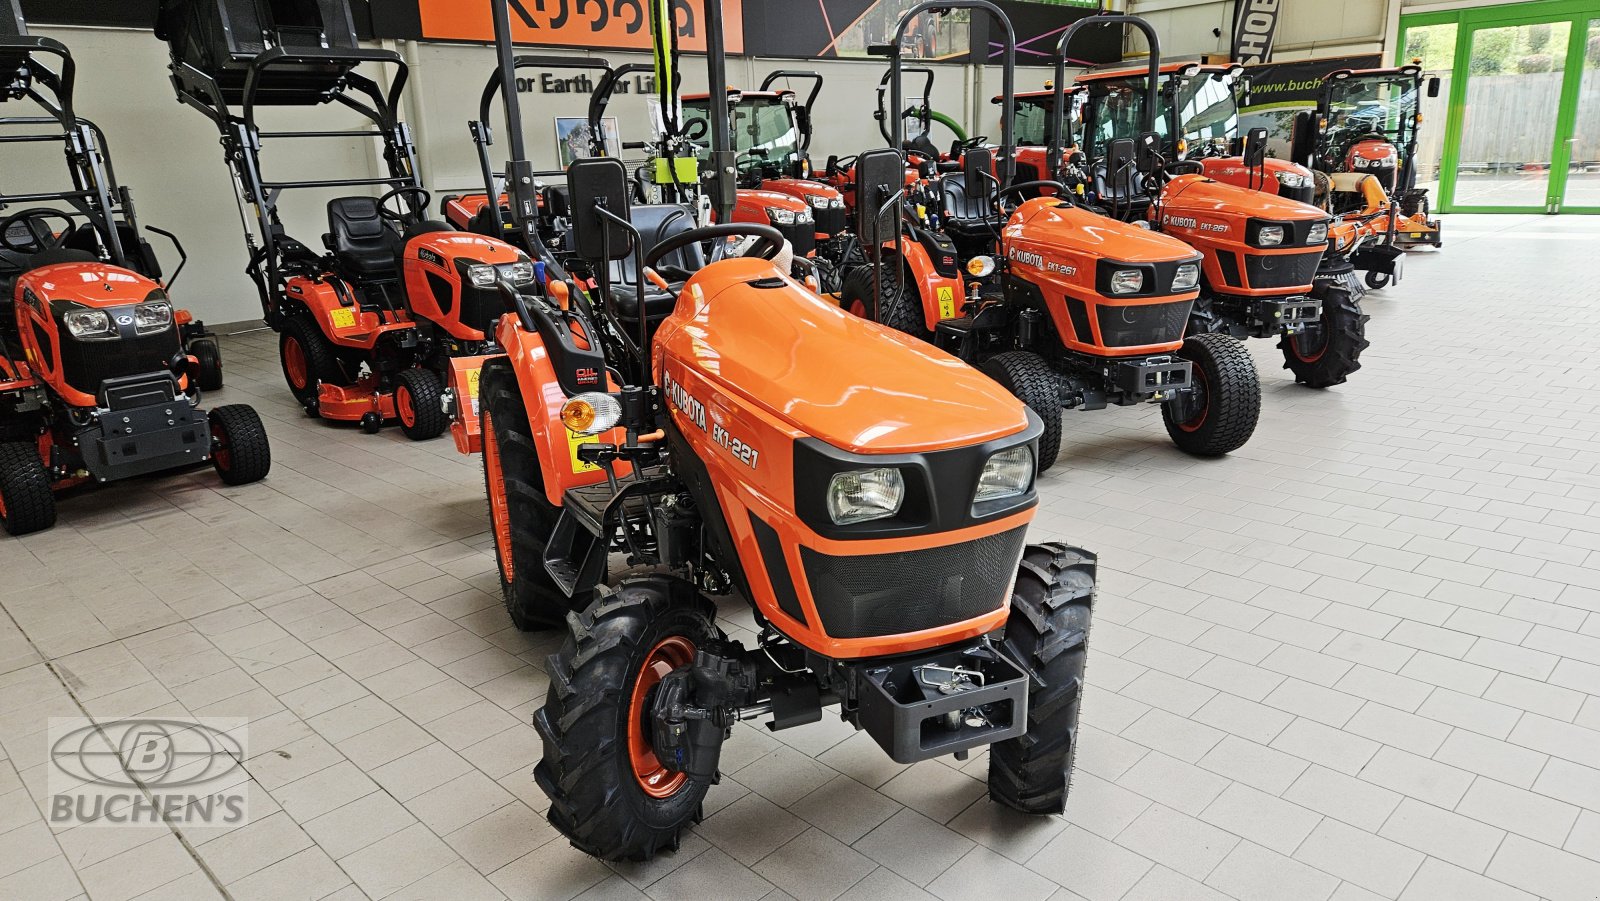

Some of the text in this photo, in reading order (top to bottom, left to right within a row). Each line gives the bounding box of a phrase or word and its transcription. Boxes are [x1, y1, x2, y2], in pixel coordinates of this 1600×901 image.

[515, 77, 535, 93] or
[1170, 215, 1229, 233] KUBOTA EK1-261
[1016, 249, 1077, 276] KUBOTA EK1-261
[672, 379, 759, 470] KUBOTA EK1-221
